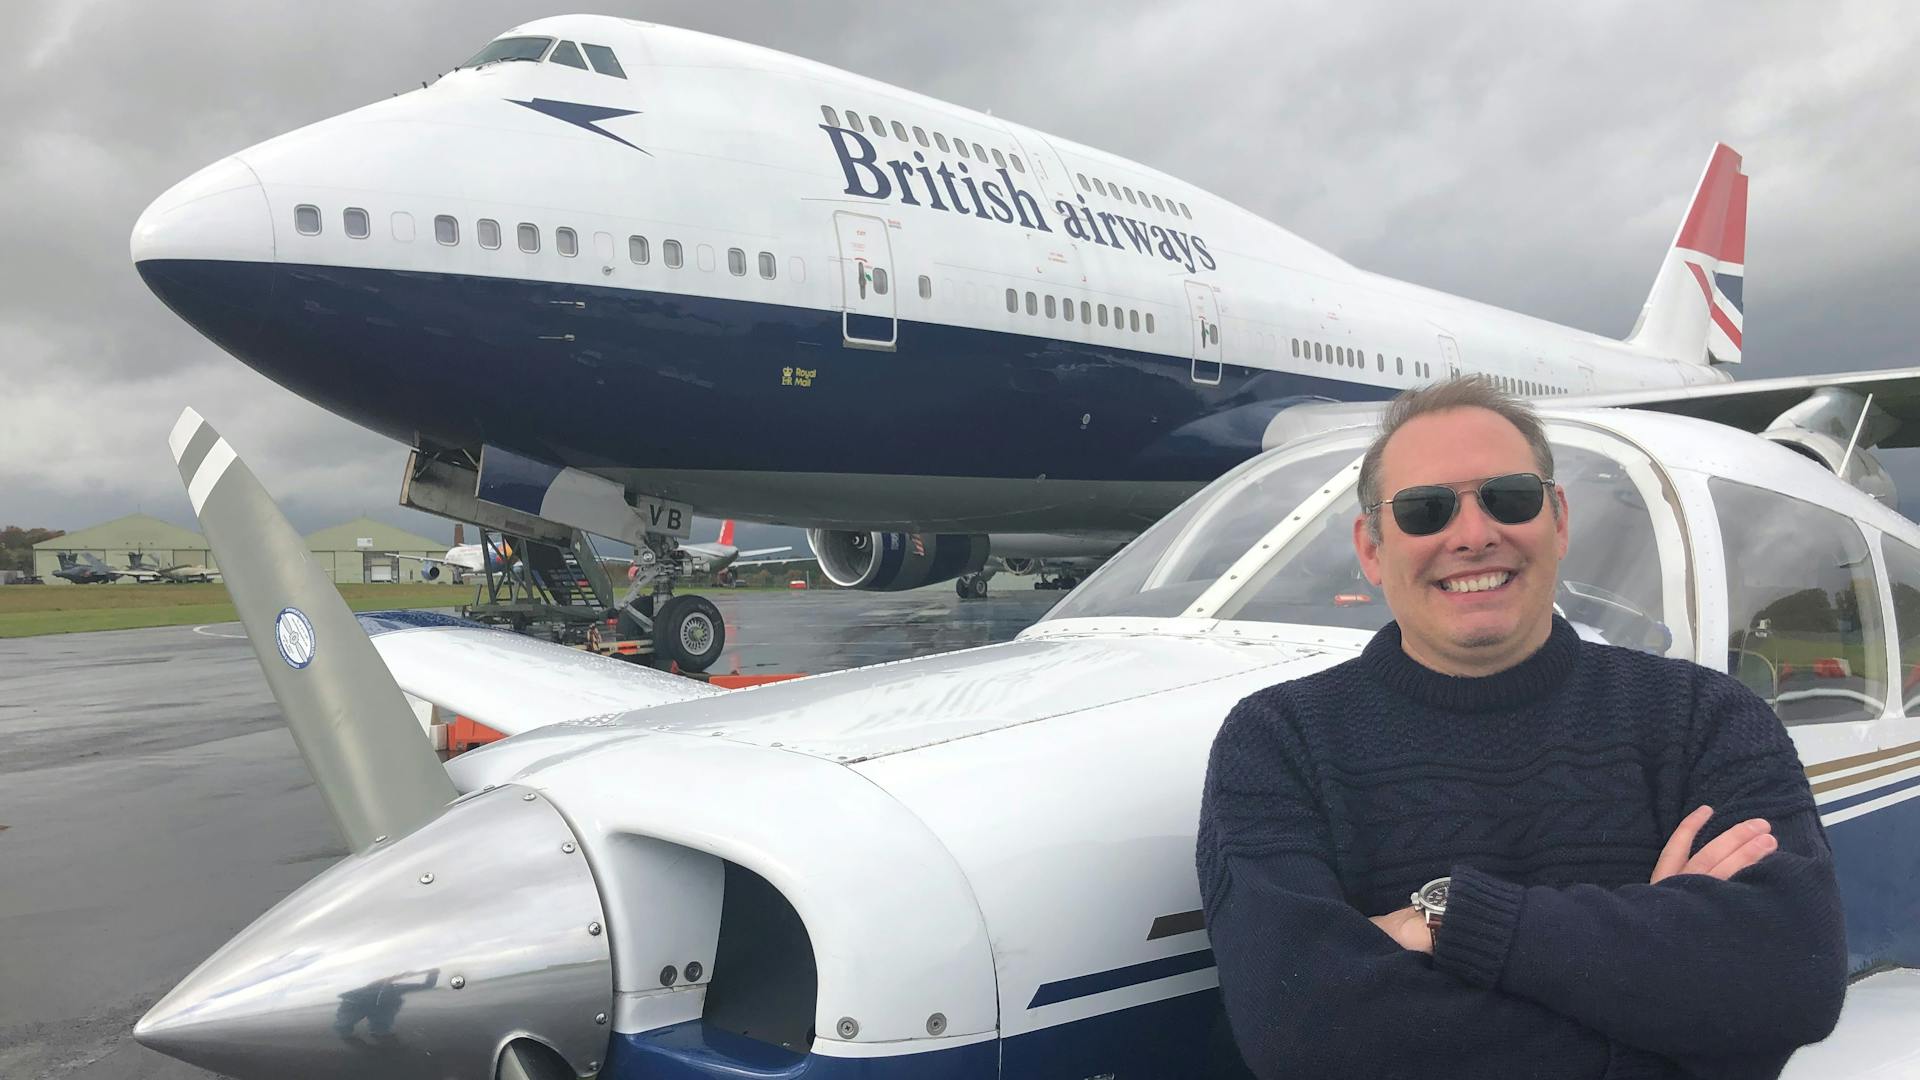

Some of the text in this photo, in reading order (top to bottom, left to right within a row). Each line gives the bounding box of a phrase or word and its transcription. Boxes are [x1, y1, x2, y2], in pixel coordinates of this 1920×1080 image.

[818, 123, 1217, 274] British airways
[794, 377, 811, 387] Mail
[795, 367, 817, 379] Royal
[650, 504, 682, 530] VB
